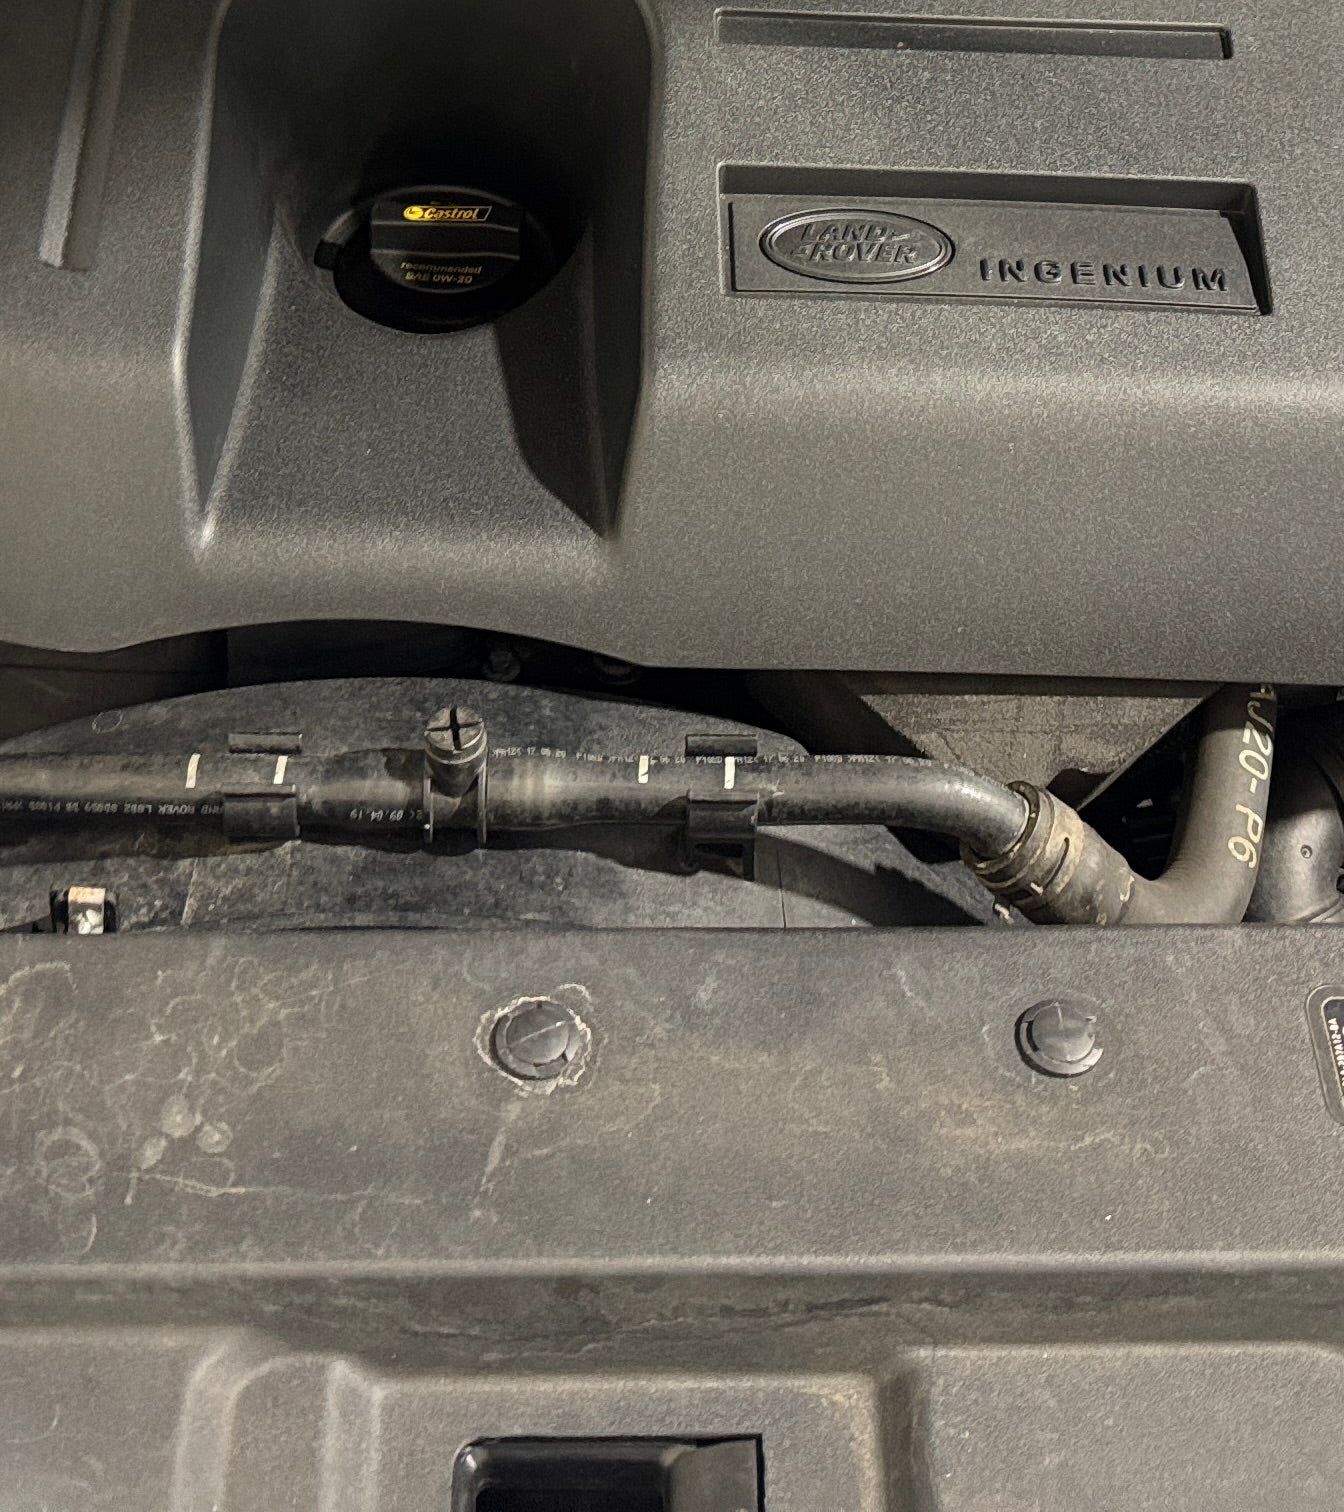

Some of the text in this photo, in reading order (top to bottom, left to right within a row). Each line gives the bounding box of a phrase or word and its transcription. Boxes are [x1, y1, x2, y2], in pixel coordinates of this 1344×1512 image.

[423, 207, 479, 221] Castrol
[809, 242, 918, 265] ROVER
[978, 256, 1230, 293] INGENIUM
